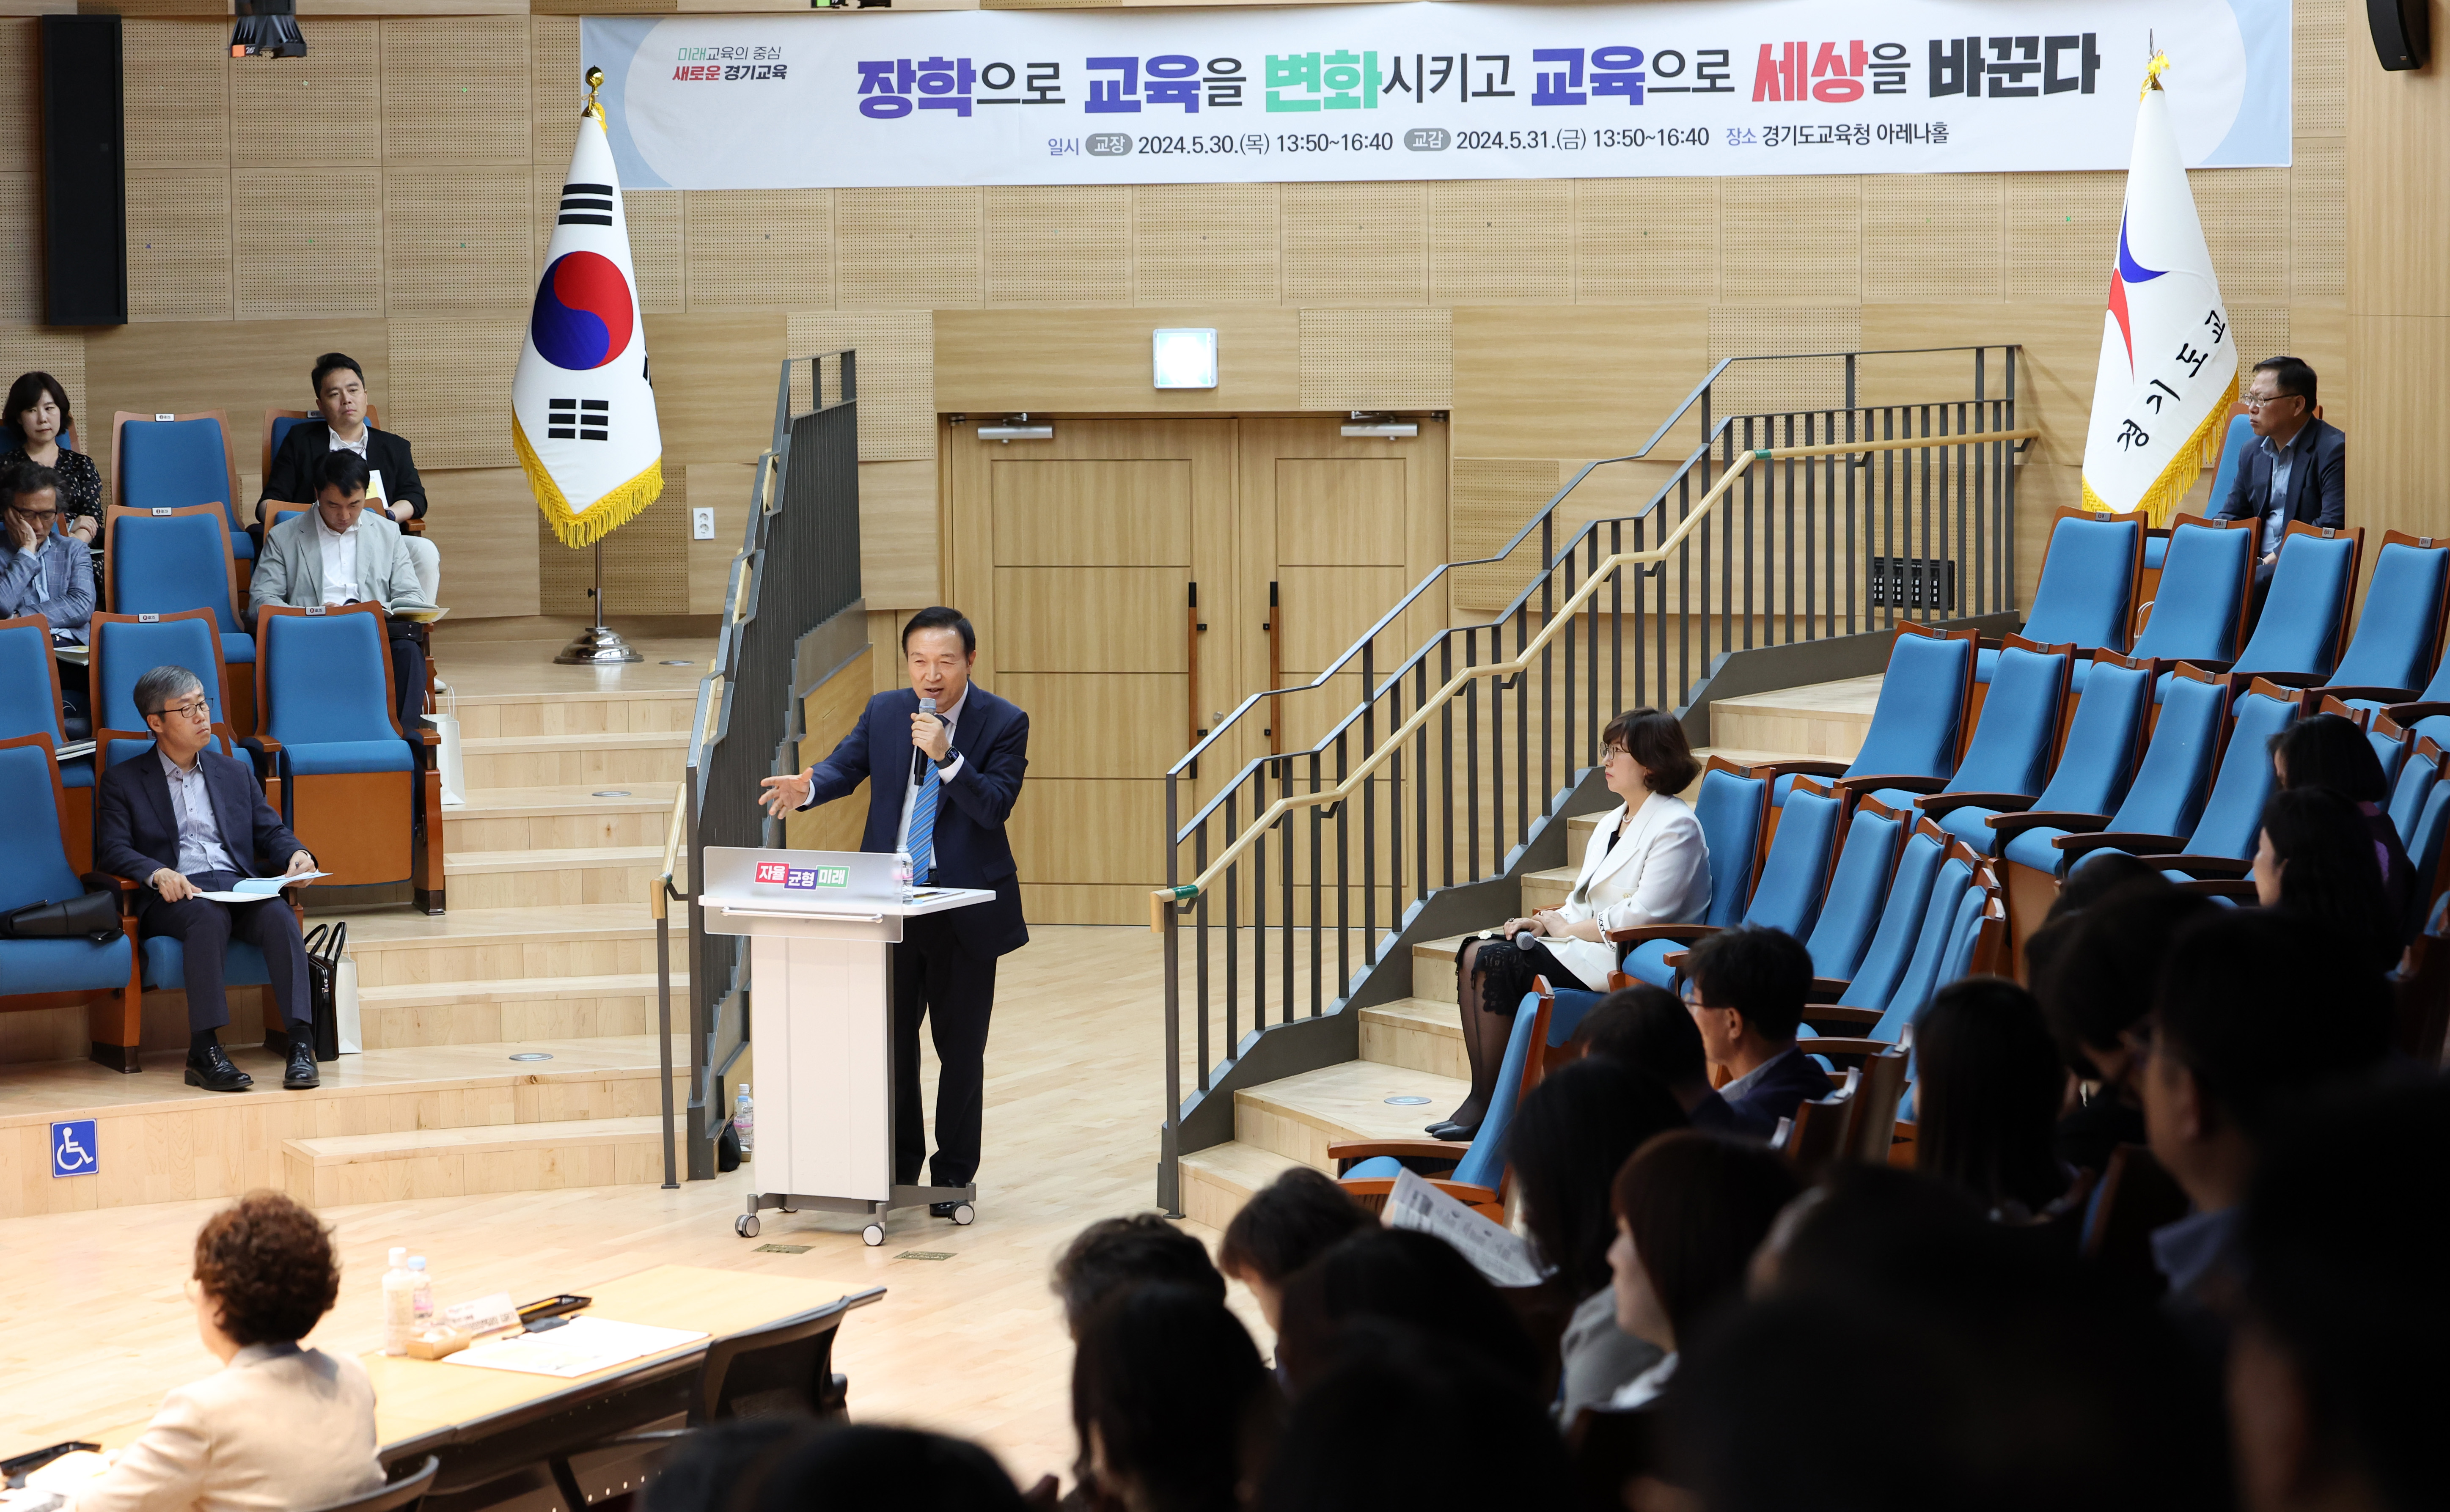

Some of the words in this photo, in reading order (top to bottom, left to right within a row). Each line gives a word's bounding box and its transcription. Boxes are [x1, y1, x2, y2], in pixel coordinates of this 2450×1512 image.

[678, 47, 748, 60] 미래교육의
[753, 47, 781, 60] 중심
[672, 66, 721, 81] 새로운
[724, 64, 788, 81] 경기교육
[857, 56, 1066, 119] 장학으로
[1084, 55, 1247, 113] 교육을
[1265, 49, 1515, 113] 변화시키고
[1531, 45, 1735, 106] 교육으로
[1752, 40, 1911, 103] 세상을
[1929, 33, 2101, 98] 바꾼다
[1048, 137, 1079, 156] 일시
[1094, 135, 1126, 153] 교장
[1138, 133, 1270, 156] 2024.5.30.(목)
[1277, 132, 1394, 152] 13:50~16:40
[1412, 132, 1443, 148] 교감
[1456, 128, 1587, 151] 2024.5.31.(금)
[1593, 126, 1710, 147] 13:50~16:40
[1726, 128, 1757, 146] 장소
[1762, 123, 1870, 147] 경기도교육청
[1876, 121, 1950, 145] 아레나홀
[759, 865, 786, 880] 자율
[788, 871, 815, 887] 균형
[818, 869, 846, 885] 미래
